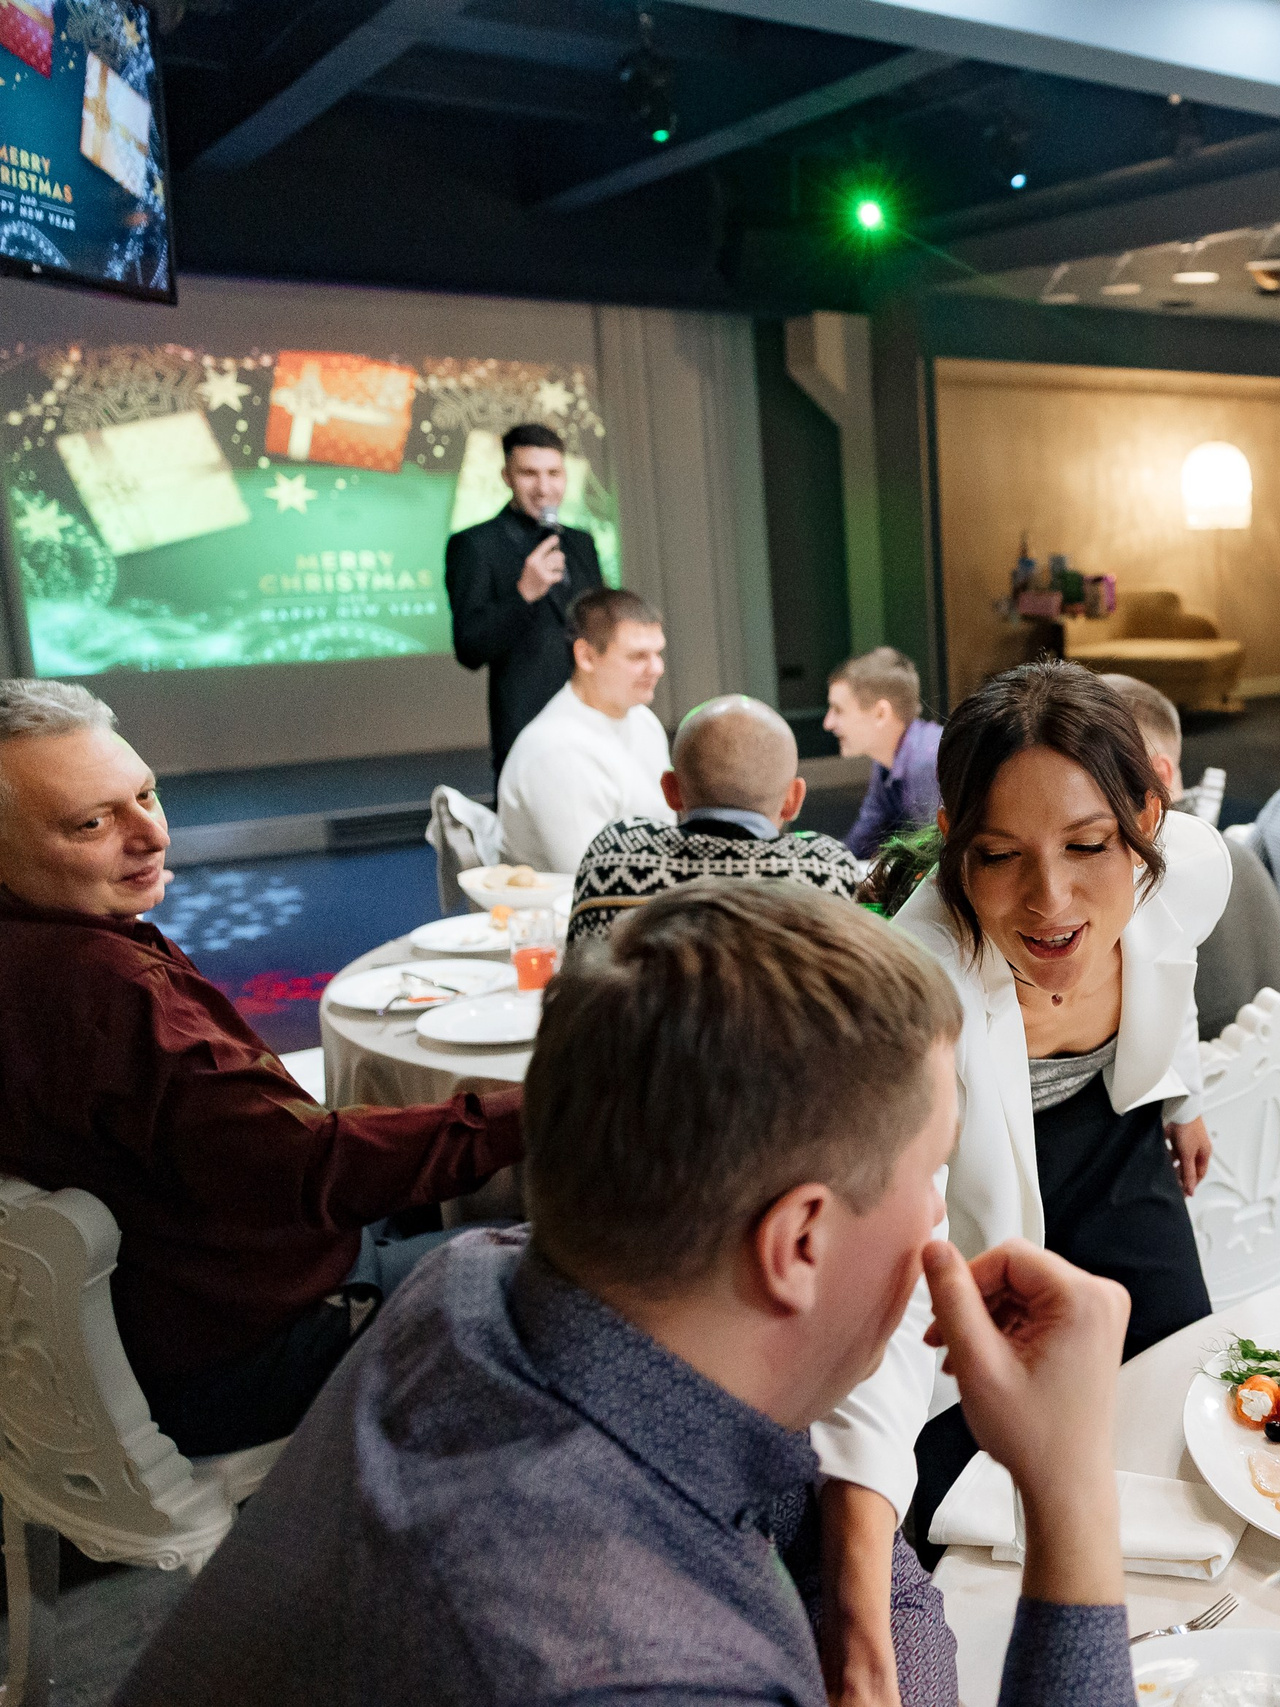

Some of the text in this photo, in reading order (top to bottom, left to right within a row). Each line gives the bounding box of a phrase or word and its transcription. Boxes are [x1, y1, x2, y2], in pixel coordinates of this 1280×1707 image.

[19, 205, 44, 222] NEW
[48, 212, 76, 231] YEAR
[296, 550, 394, 572] MERRY
[258, 569, 432, 595] CHRISTMAS
